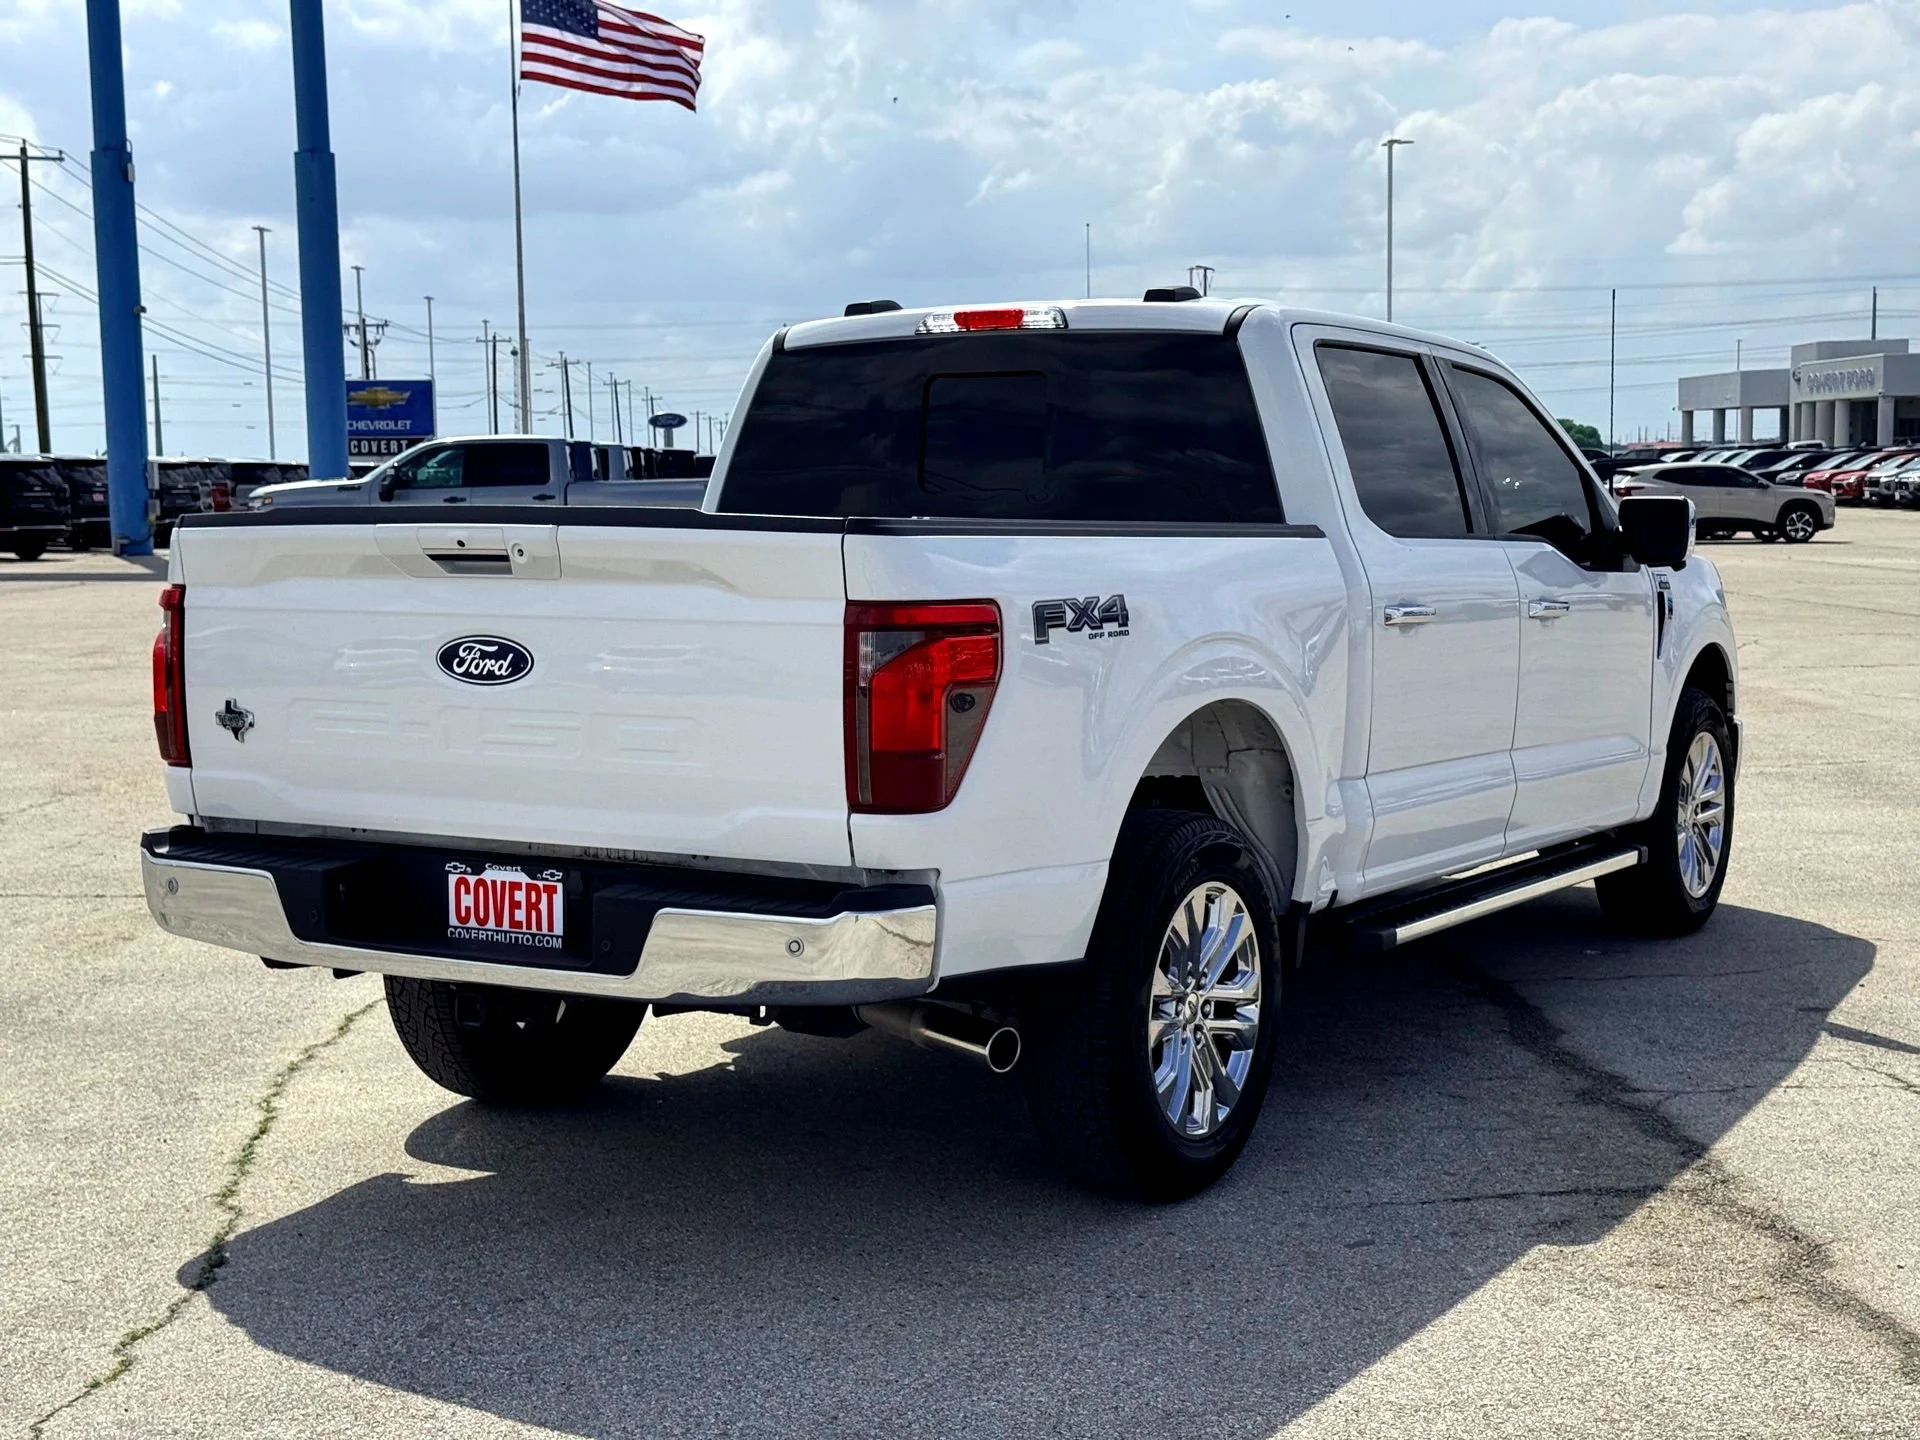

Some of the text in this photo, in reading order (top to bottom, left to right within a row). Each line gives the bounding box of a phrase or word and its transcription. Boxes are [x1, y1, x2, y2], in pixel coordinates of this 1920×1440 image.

[347, 420, 411, 430] CHEVROLET
[350, 440, 408, 454] COVERT
[1032, 594, 1129, 645] FX4
[1088, 629, 1130, 640] OFF ROAD
[452, 643, 514, 676] Ford
[485, 863, 521, 872] Covert
[454, 876, 558, 933] COVERT
[447, 928, 562, 948] COVERTHUTTO.COM
